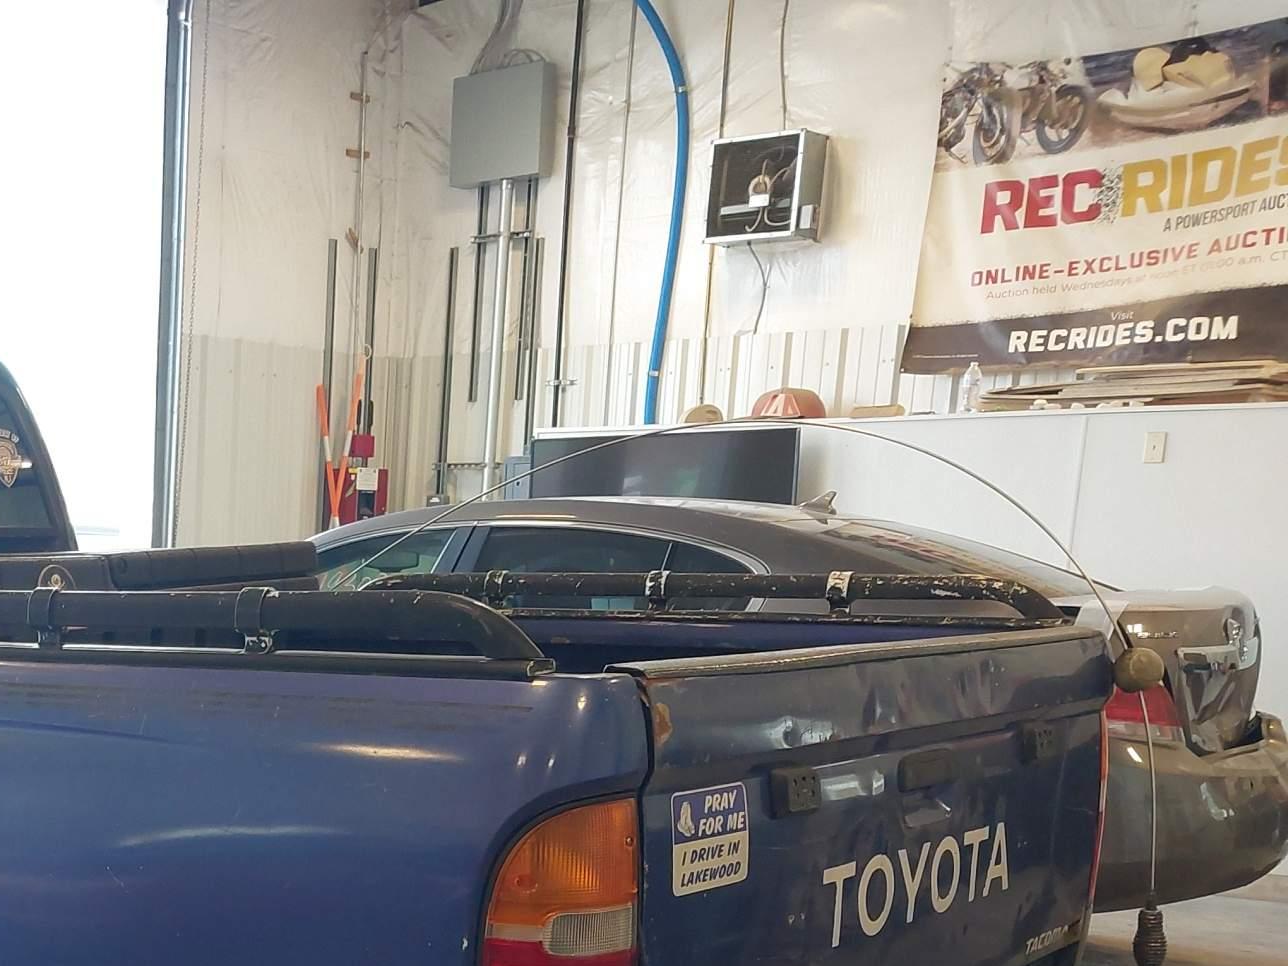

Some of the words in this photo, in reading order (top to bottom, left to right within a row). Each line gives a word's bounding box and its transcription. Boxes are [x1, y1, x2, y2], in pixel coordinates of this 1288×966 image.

[980, 169, 1103, 234] REC
[1163, 217, 1172, 232] A
[1175, 199, 1258, 231] POWERSPORT
[1258, 193, 1288, 213] AUC
[970, 241, 1200, 287] ONLINE-EXCLUSIVE
[1207, 226, 1288, 256] AUCTI
[986, 287, 1029, 299] Auction
[1032, 283, 1057, 295] held
[1061, 275, 1131, 292] Wednesdays
[1111, 311, 1134, 321] Visit
[1008, 315, 1240, 353] RECRIDES.COM
[704, 789, 737, 814] PRAY
[698, 815, 723, 837] FOR
[727, 811, 745, 832] ME
[681, 851, 687, 866] I
[690, 843, 725, 864] DRIVE
[727, 840, 740, 857] IN
[680, 861, 742, 888] LAKEWOOD
[822, 822, 1009, 948] TOYOTA
